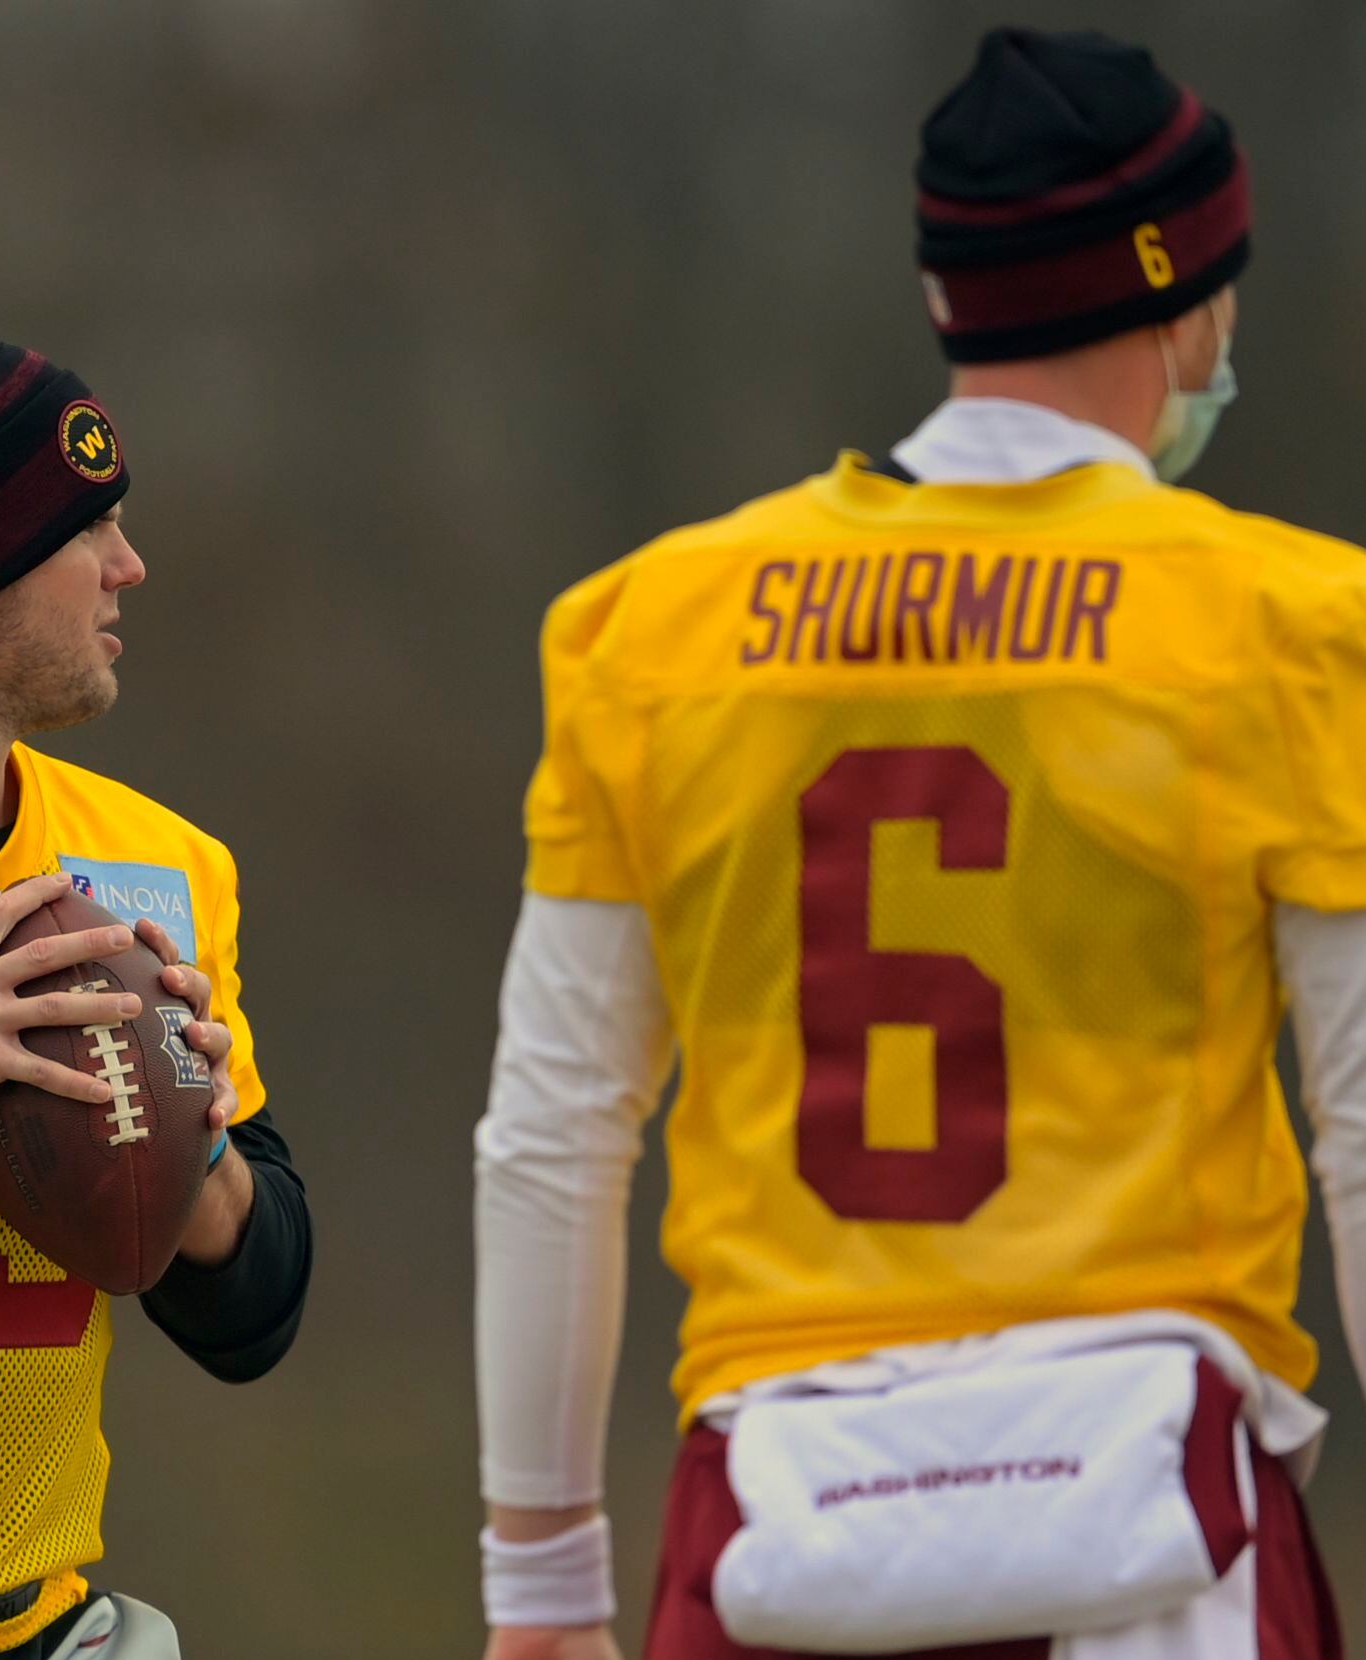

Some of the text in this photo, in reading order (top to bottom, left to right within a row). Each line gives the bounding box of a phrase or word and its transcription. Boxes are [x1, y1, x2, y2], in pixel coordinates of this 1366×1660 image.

[1132, 222, 1175, 289] 6
[76, 425, 105, 460] W
[79, 464, 115, 477] FOOTBALL
[740, 551, 1121, 664] SHURMUR
[98, 882, 187, 919] INOVA
[796, 745, 1010, 1223] 6
[814, 1456, 1081, 1511] WASHINGTON
